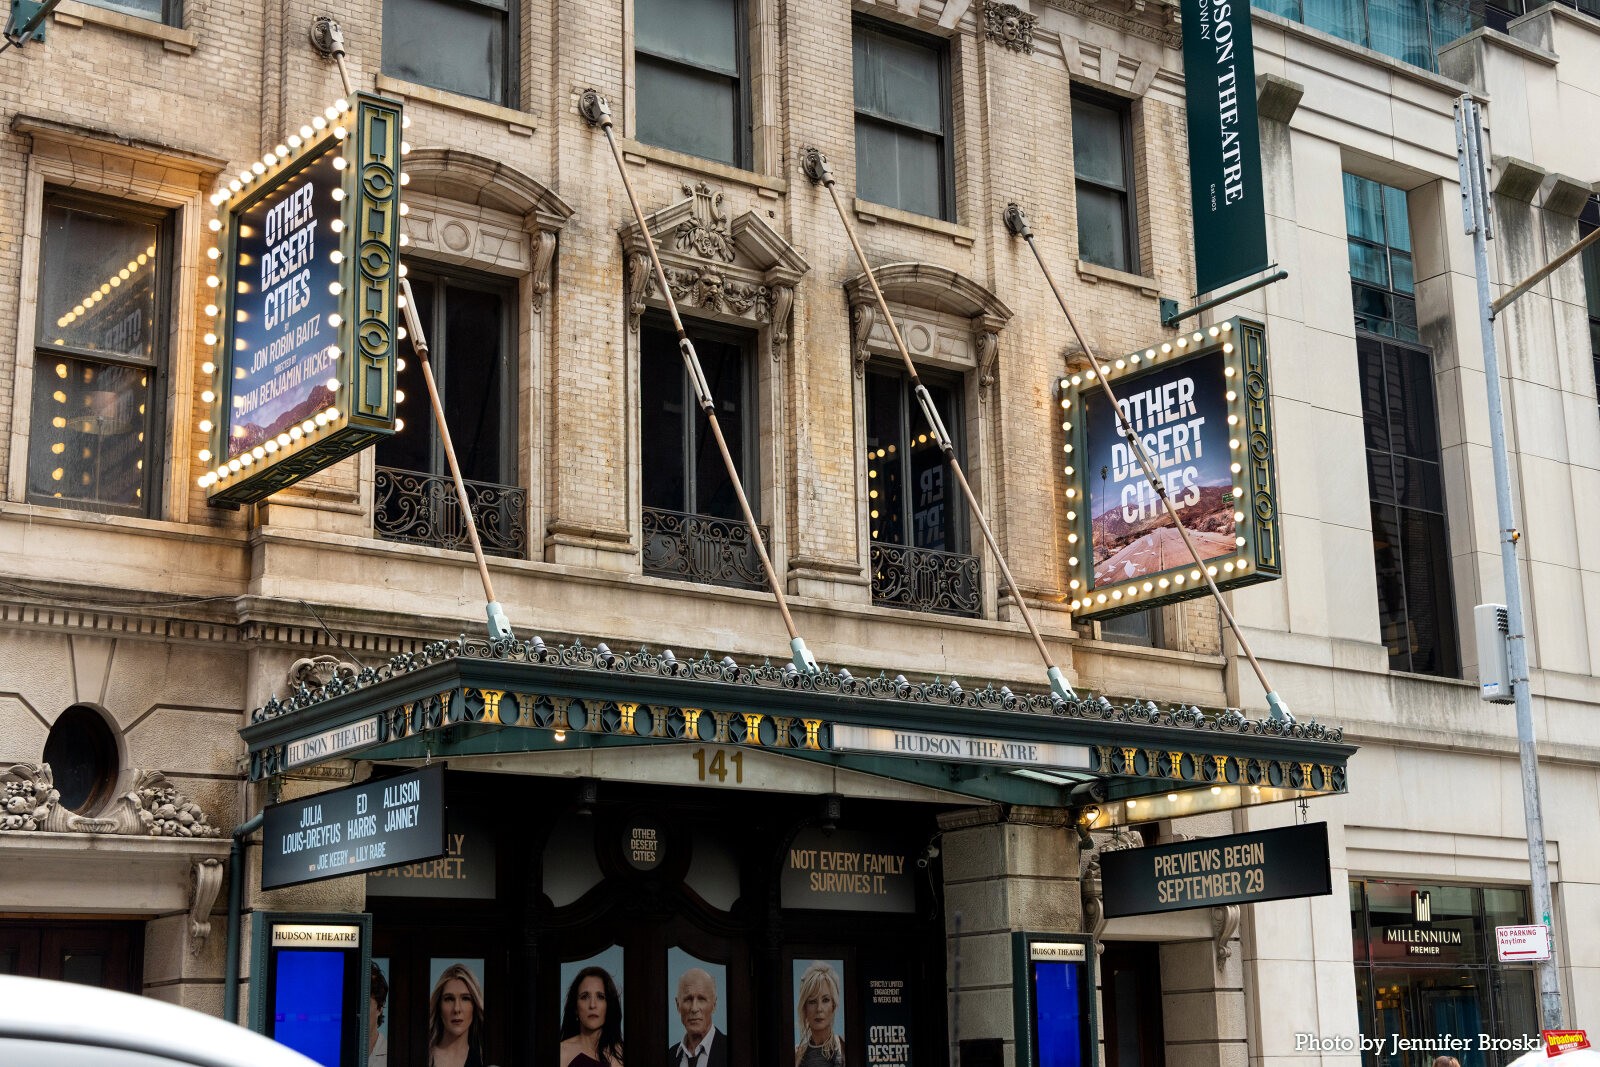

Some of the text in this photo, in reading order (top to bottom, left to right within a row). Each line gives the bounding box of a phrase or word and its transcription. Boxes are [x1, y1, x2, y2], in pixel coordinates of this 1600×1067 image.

[1218, 65, 1243, 206] THEATRE
[265, 182, 314, 247] OTHER
[262, 219, 318, 293] DESERT
[264, 268, 311, 331] CITIES
[250, 314, 320, 374] JON ROBIN BAITZ
[260, 364, 302, 406] BENJAMIN
[1114, 377, 1197, 438] OTHER
[1112, 416, 1205, 483] DESERT
[1121, 466, 1200, 524] CITIES
[289, 720, 377, 763] HUDSON THEATRE
[894, 734, 1038, 761] HUDSON THEATRE
[693, 748, 743, 784] 141
[356, 794, 368, 816] ED
[384, 780, 420, 809] ALLISON
[300, 804, 322, 829] JULIA
[348, 814, 376, 841] HARRIS
[384, 804, 419, 832] JANNEY
[282, 822, 341, 855] LOUIS-DREYFUS
[630, 838, 658, 850] DESERT
[632, 828, 656, 840] OTHER
[316, 854, 328, 871] JOE
[329, 849, 348, 868] KEERY
[356, 845, 369, 863] LILY
[369, 842, 386, 860] RABE
[403, 858, 466, 880] SECRET.
[632, 850, 656, 862] CITIES
[790, 849, 904, 874] NOT EVERY FAMILY
[1154, 842, 1264, 878] PREVIEWS BEGIN
[810, 872, 887, 894] SURVIVES IT.
[1158, 868, 1264, 904] SEPTEMBER 29
[275, 931, 356, 942] HUDSON THEATRE
[1387, 929, 1461, 944] MILLENNIUM
[1410, 946, 1440, 954] PREMIER
[1058, 948, 1084, 956] THEATRE
[870, 1026, 906, 1044] OTHER
[868, 1044, 910, 1062] DESERT
